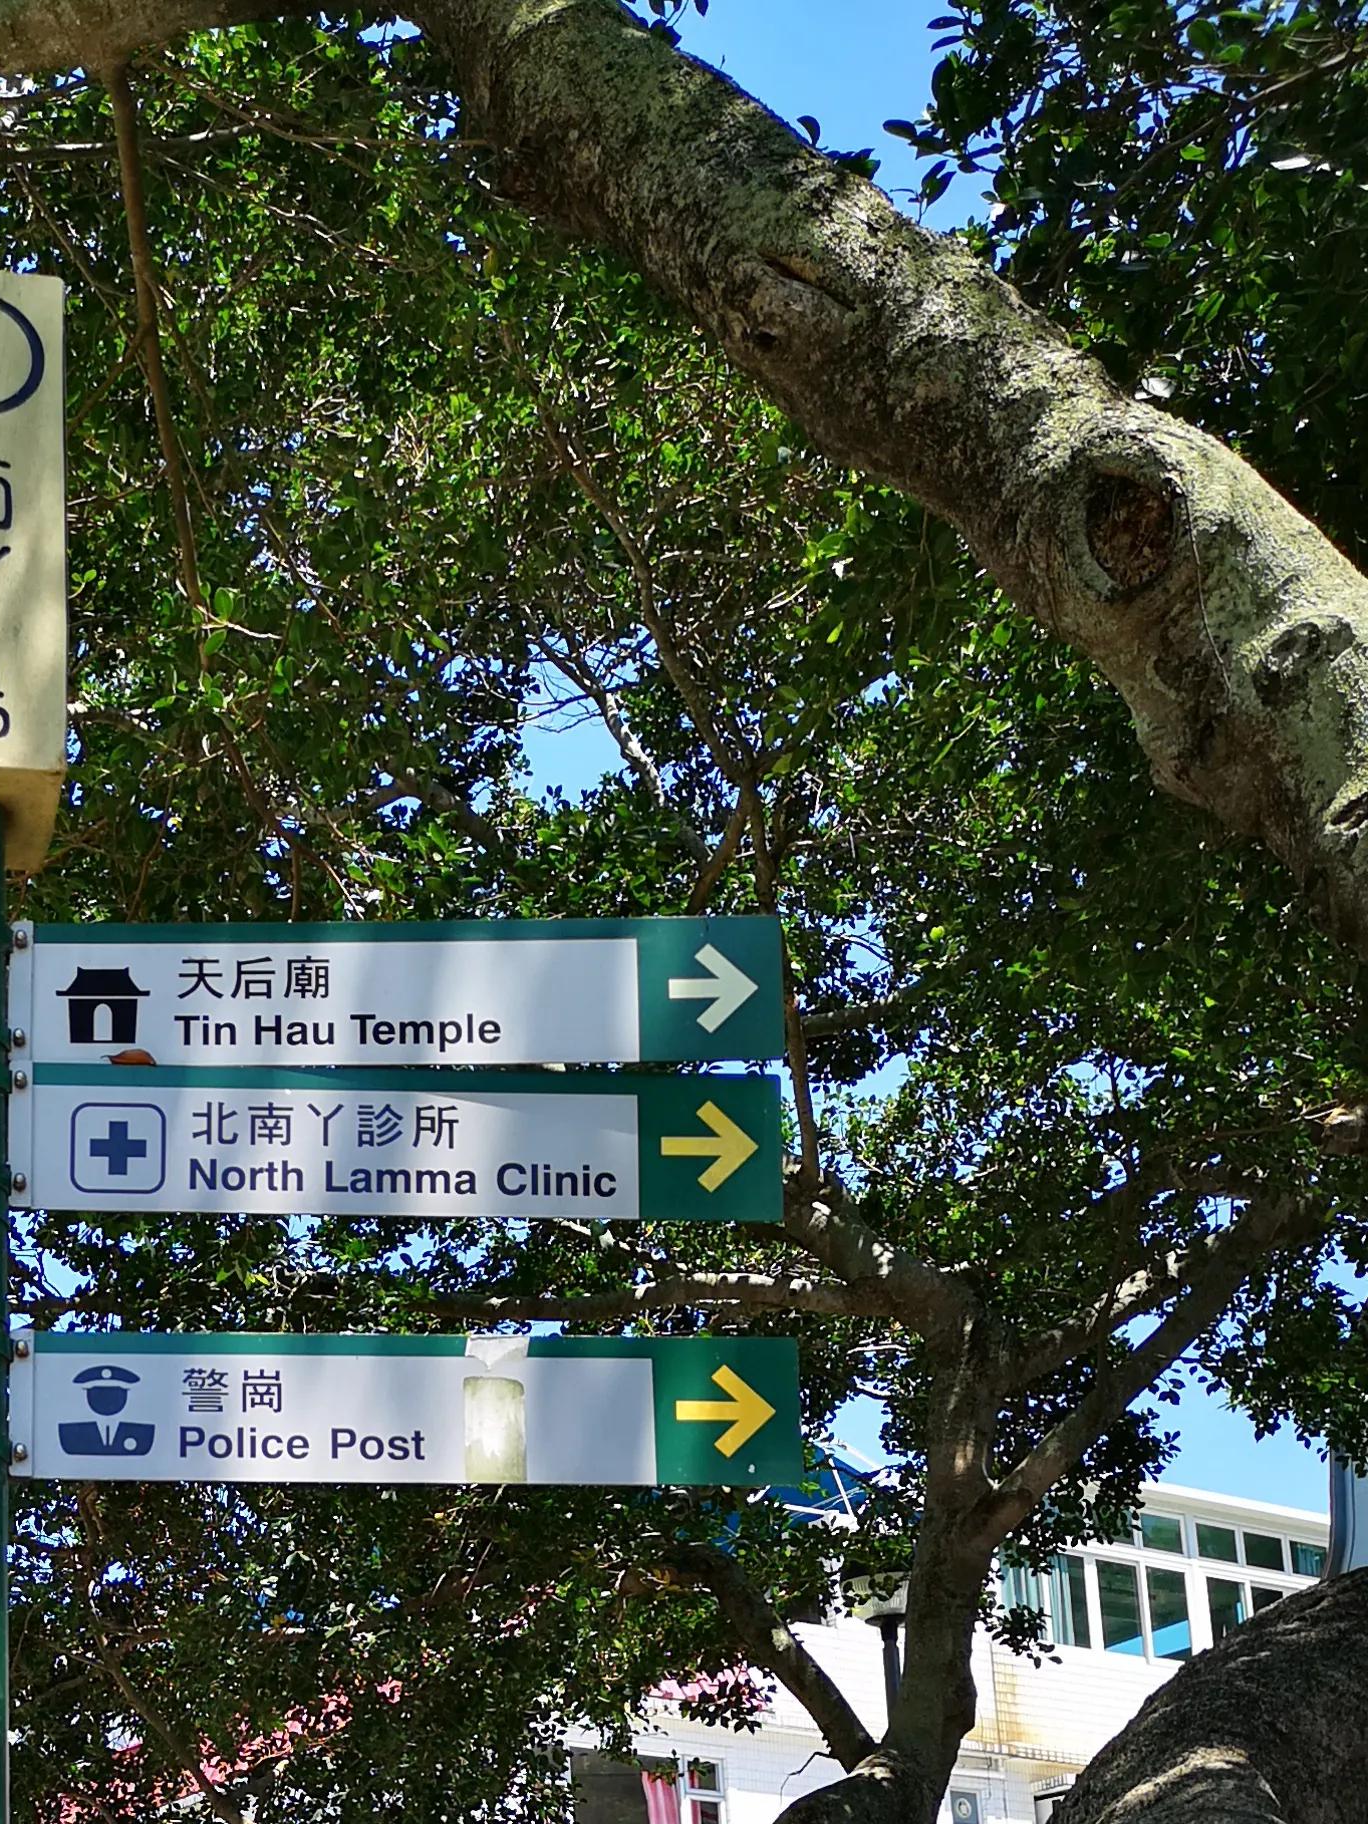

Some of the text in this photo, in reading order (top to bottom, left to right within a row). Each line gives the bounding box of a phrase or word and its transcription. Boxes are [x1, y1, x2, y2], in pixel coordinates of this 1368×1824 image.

[177, 956, 330, 1000] 天后廟
[175, 1014, 502, 1054] Tin Hau Temple
[191, 1101, 460, 1150] 北南丫診所
[188, 1158, 617, 1199] North Lamma Clinic
[181, 1367, 285, 1415] 警崗
[179, 1426, 426, 1462] Police Post
